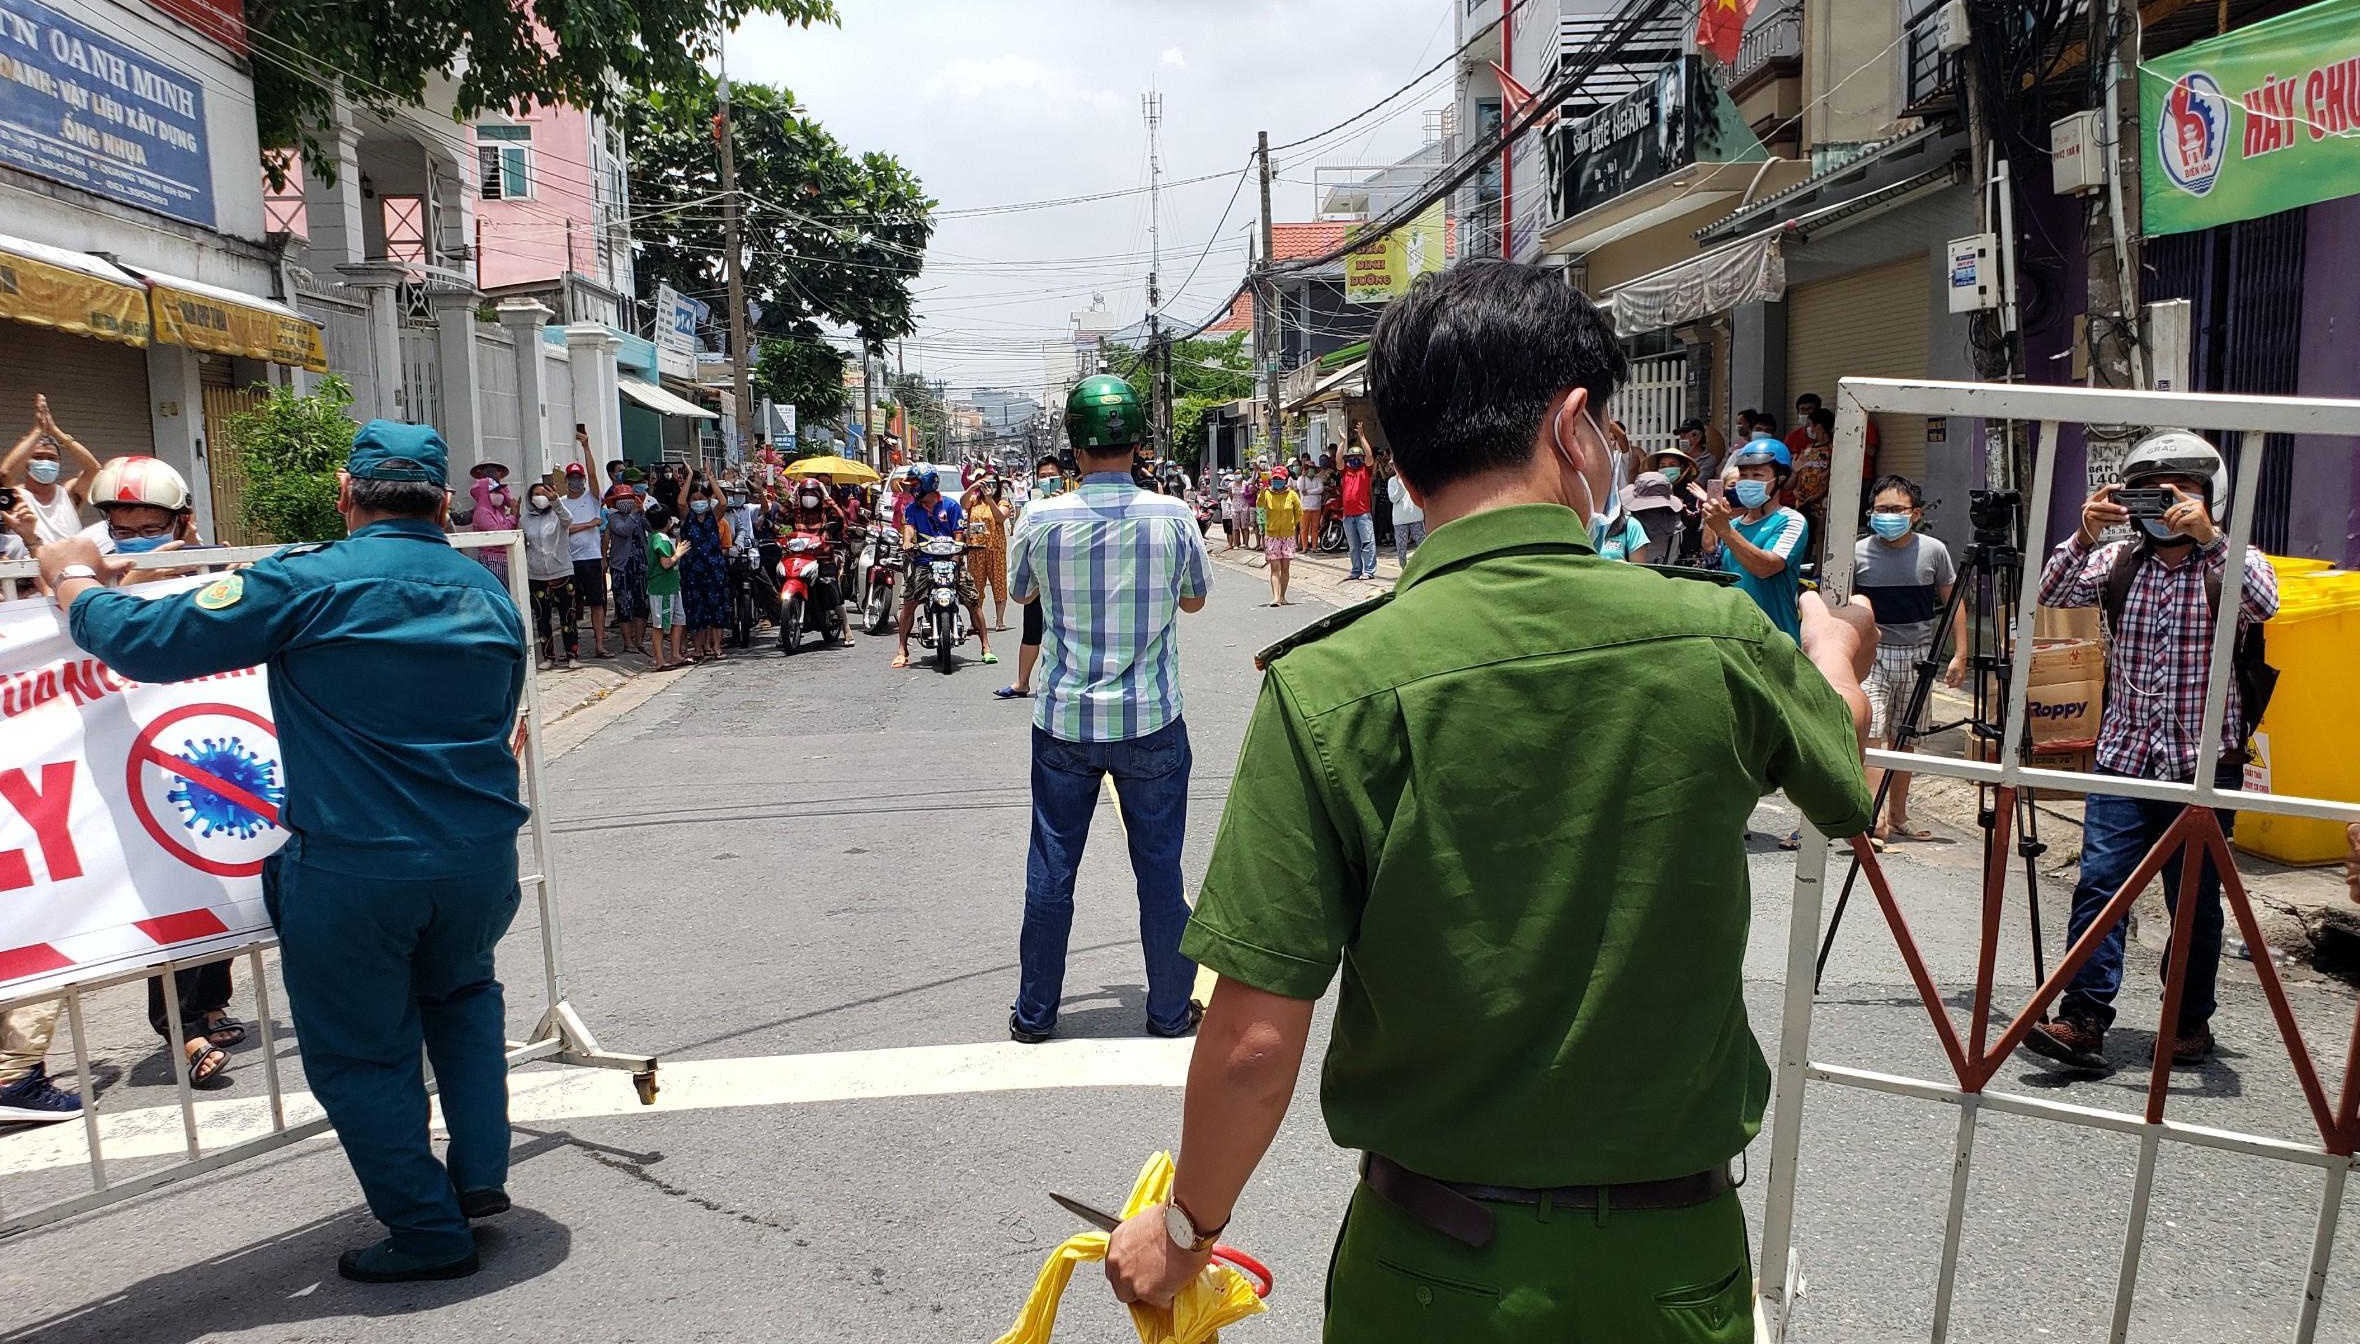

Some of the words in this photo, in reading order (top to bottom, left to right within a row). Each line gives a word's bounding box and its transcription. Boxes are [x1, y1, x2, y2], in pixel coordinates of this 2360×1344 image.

[50, 28, 129, 91] OANH
[131, 65, 197, 121] MINH
[57, 78, 89, 111] VẬT
[91, 92, 124, 125] LIỆU
[125, 106, 157, 137] XÂY
[159, 120, 198, 153] DỰNG
[102, 131, 147, 167] NHỰA
[2243, 72, 2297, 159] HÃY
[2029, 701, 2089, 721] Roppy
